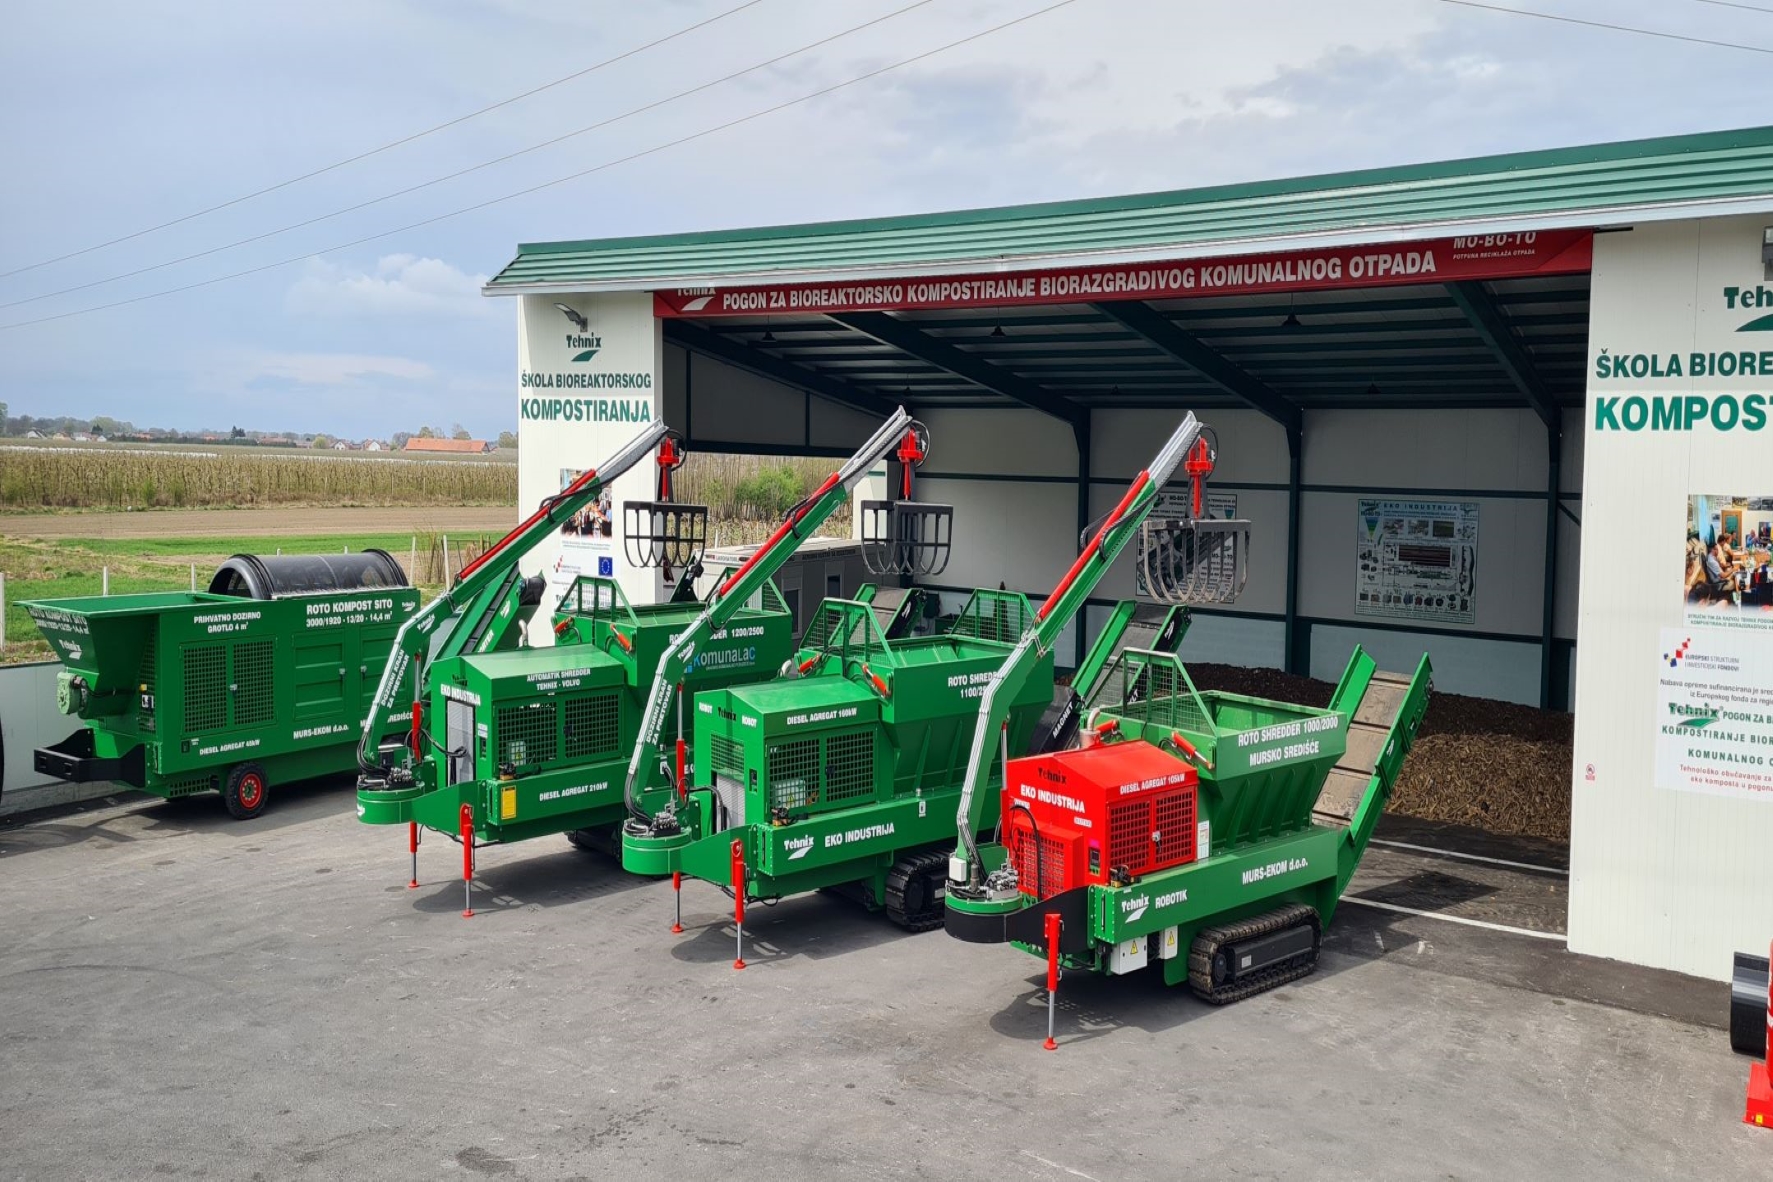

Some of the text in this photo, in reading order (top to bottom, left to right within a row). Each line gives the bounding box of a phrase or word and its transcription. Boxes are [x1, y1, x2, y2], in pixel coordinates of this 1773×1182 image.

[723, 250, 1437, 310] POGON ZA BIOREAKTORSKO KOMPOSTIRANJE BIORAZGRADIVOG KOMUNALNOG OTPADA
[566, 332, 602, 348] Tehnix
[1595, 348, 1773, 378] ŠKOLA BIORE
[521, 370, 651, 389] ŠKOLA BIOREAKTORSKOG
[521, 399, 651, 422] KOMPOSTIRANJA
[1595, 394, 1773, 432] KOMPOS
[1404, 503, 1458, 511] INDUSTRIJA
[306, 598, 393, 616] ROTO KOMPOST SITO
[193, 611, 261, 624] PRIHVATNO DOZIRNO
[306, 617, 342, 629] 3000/1920
[347, 615, 365, 625] 13/20
[369, 613, 384, 623] 14,4
[207, 623, 234, 633] GROTLO
[731, 626, 764, 638] 1200/2500
[394, 649, 405, 674] KRAN
[386, 654, 410, 709] ZA PRETOVAR
[526, 668, 591, 682] AUTOMATIK SHREDDER
[947, 674, 968, 687] ROTO
[536, 679, 581, 691] TEHNIX VOLVO
[1660, 679, 1683, 687] Nabava
[1684, 682, 1708, 690] opreme
[1709, 683, 1752, 693] sufinancirana
[1752, 687, 1759, 695] je
[440, 683, 481, 707] EKO INDUSTRIJA
[1696, 691, 1730, 701] Europskog
[1731, 694, 1749, 702] fonda
[656, 684, 673, 733] PRETOVAR
[786, 714, 809, 725] DIESEL
[809, 710, 838, 723] AGREGAT
[1668, 702, 1720, 717] Tehnix
[1723, 711, 1751, 722] POGON
[1753, 714, 1764, 723] ZA
[1052, 701, 1073, 739] MAGNET
[293, 724, 350, 740] MURS-EKOM d.o.o.
[1238, 716, 1339, 747] ROTO SHREDDER 1000/2000
[1662, 725, 1746, 742] KOMPOSTIRANJE
[199, 745, 219, 756] DIESEL
[1249, 748, 1282, 767] MURSKO
[1688, 748, 1764, 765] KOMUNALNOG
[1038, 767, 1067, 785] Tehnix
[1680, 764, 1719, 775] Tehnološko
[539, 790, 560, 802] DIESEL
[560, 785, 589, 798] AGREGAT
[1120, 783, 1141, 795] DIESEL
[1141, 777, 1167, 791] AGREGAT
[1020, 784, 1036, 799] EKO
[1037, 789, 1086, 814] INDUSTRIJA
[783, 822, 895, 851] Tehnix EKO INDUSTRIJA
[1242, 857, 1309, 886] MURS-EKOM d.o.o.
[1121, 889, 1188, 913] Tehnix ROBOTIK
